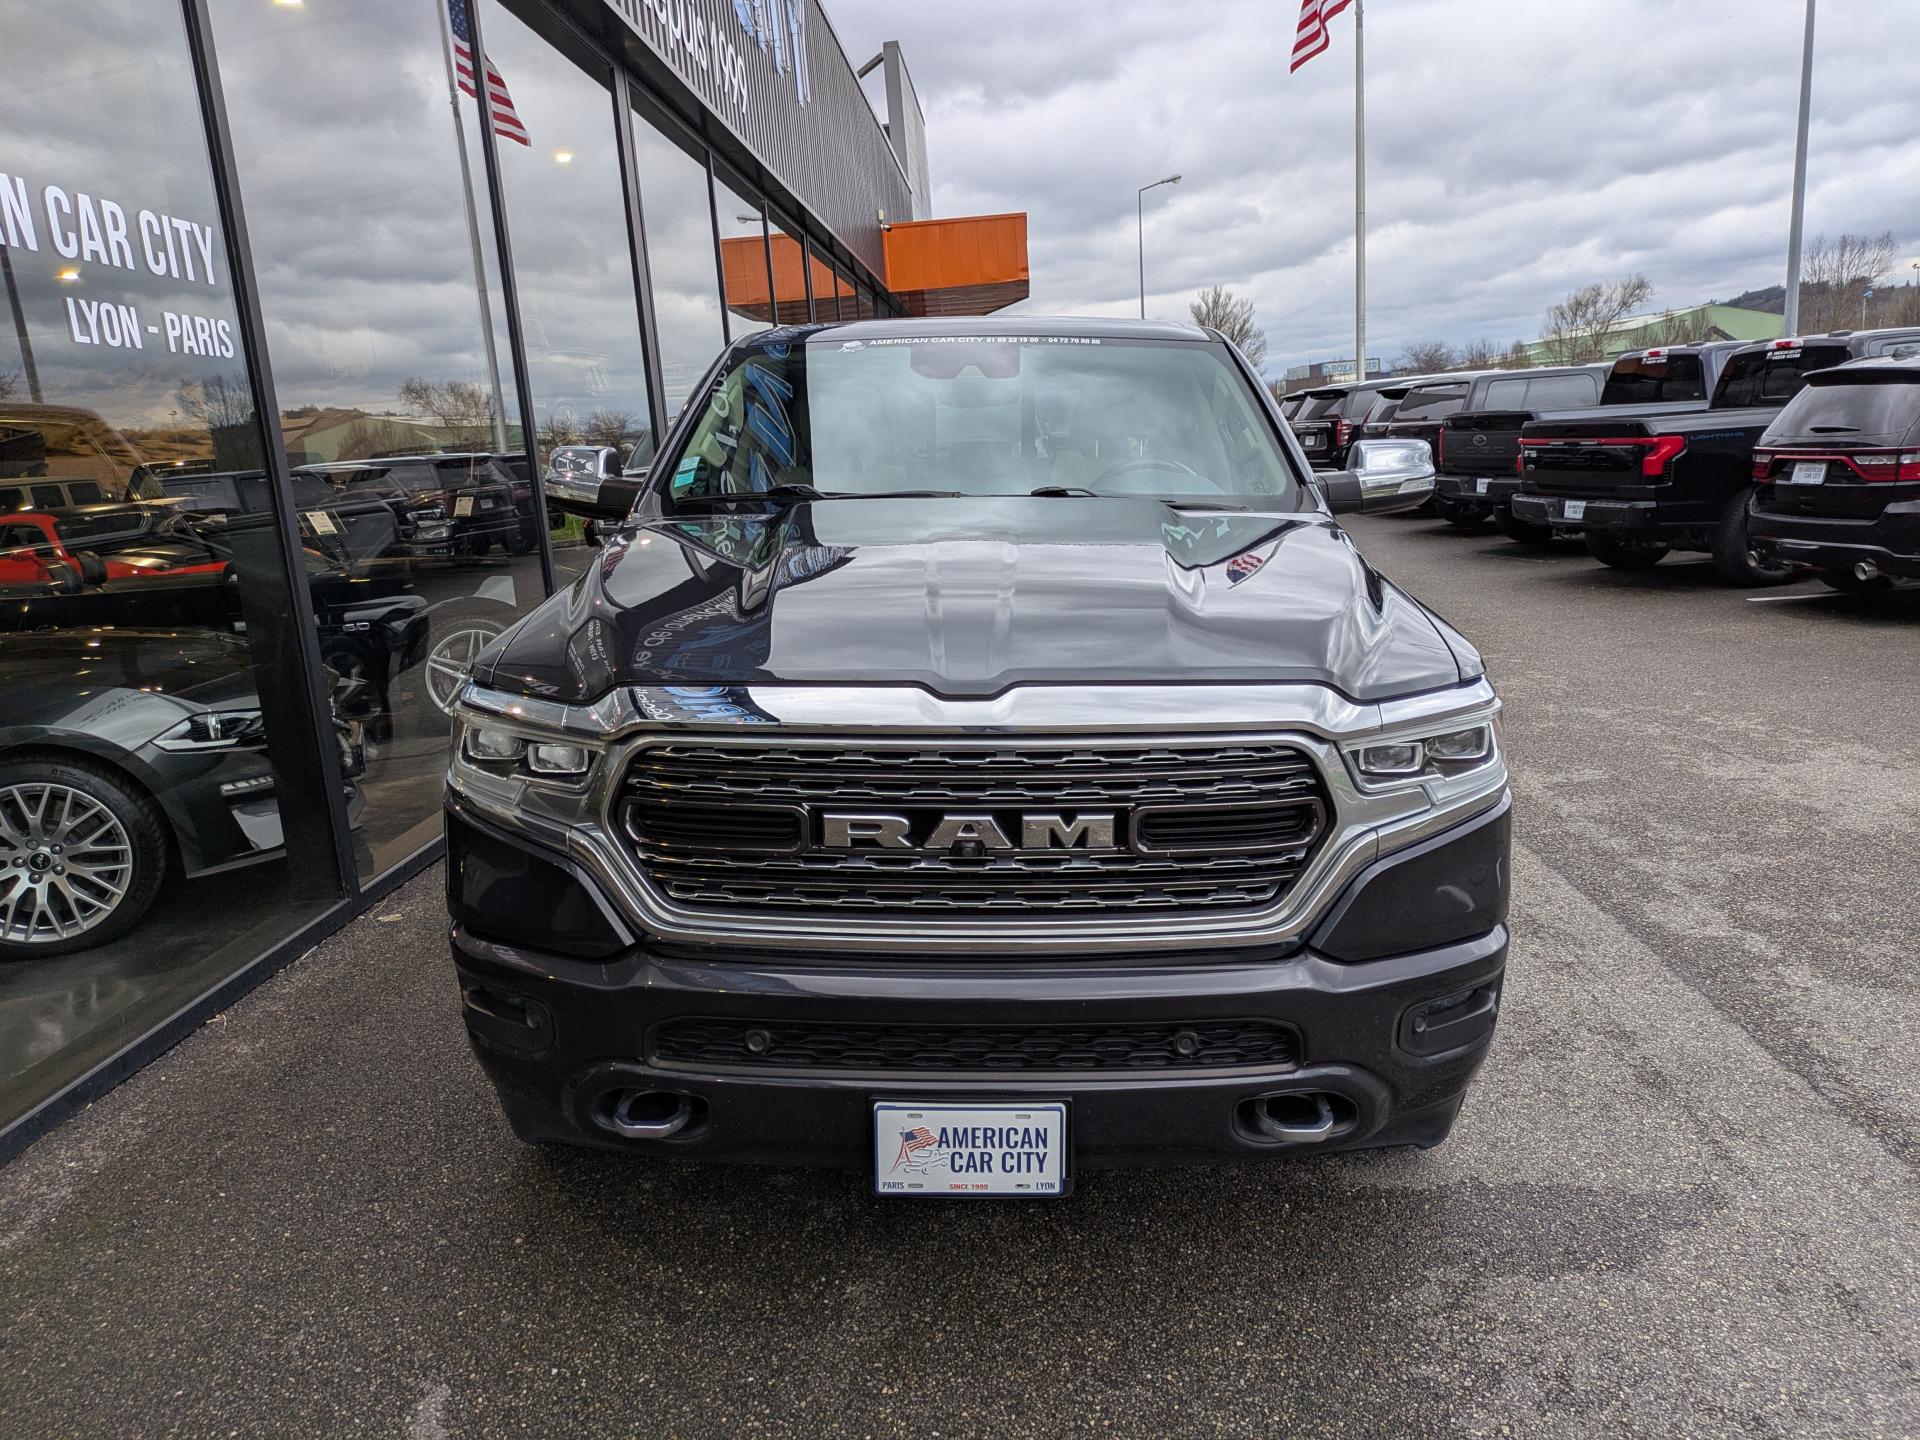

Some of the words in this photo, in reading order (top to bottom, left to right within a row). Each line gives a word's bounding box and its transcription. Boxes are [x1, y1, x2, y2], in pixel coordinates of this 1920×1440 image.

[710, 20, 748, 114] 1999
[44, 185, 135, 270] CAR
[138, 209, 215, 285] CITY
[65, 297, 142, 349] LYON
[162, 311, 234, 358] PARIS
[823, 813, 1115, 848] RAM
[937, 1126, 1048, 1149] AMERICAN
[950, 1151, 994, 1173] CAR
[1001, 1151, 1048, 1173] CITY
[882, 1181, 905, 1189] PARIS
[1036, 1181, 1056, 1190] LYON
